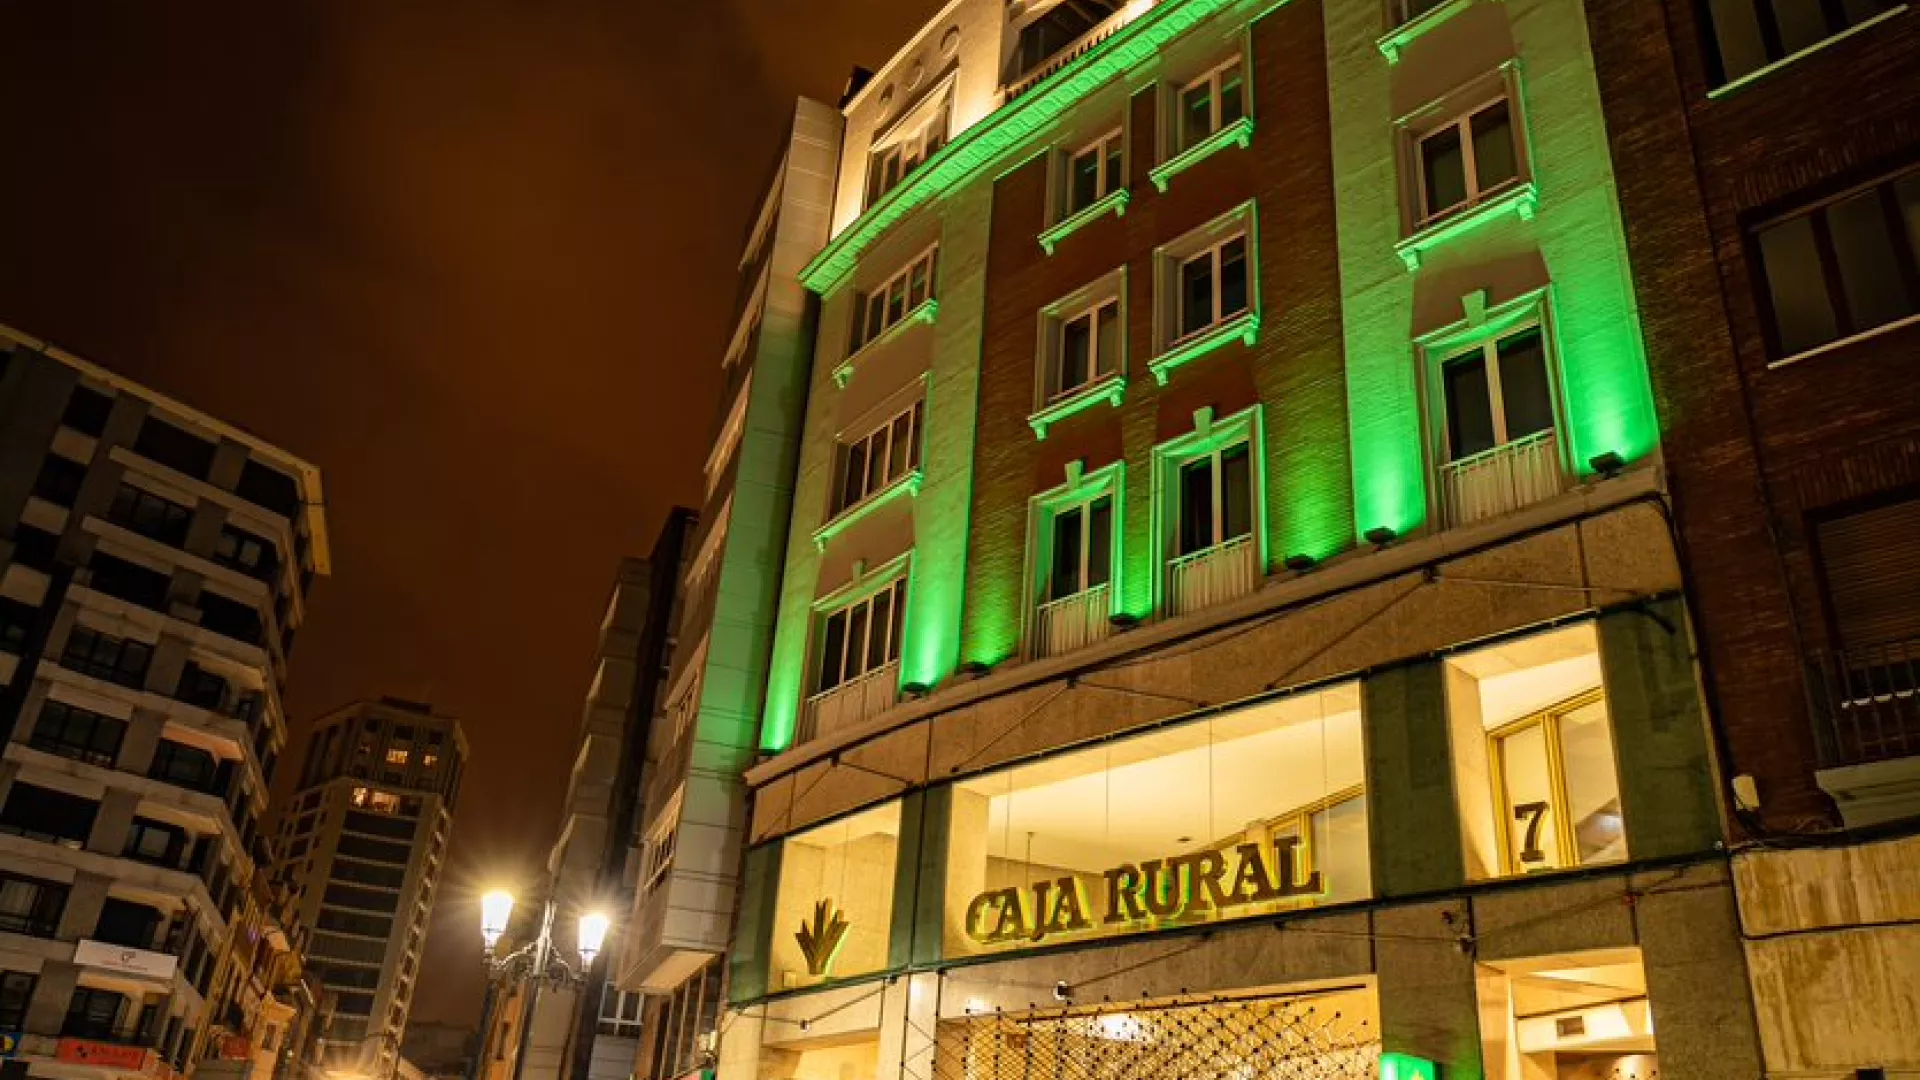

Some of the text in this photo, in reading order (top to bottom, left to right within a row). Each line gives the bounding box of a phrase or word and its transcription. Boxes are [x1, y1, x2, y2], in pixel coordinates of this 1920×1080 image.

[1513, 801, 1550, 863] 7
[966, 835, 1325, 944] CAJA RURAL
